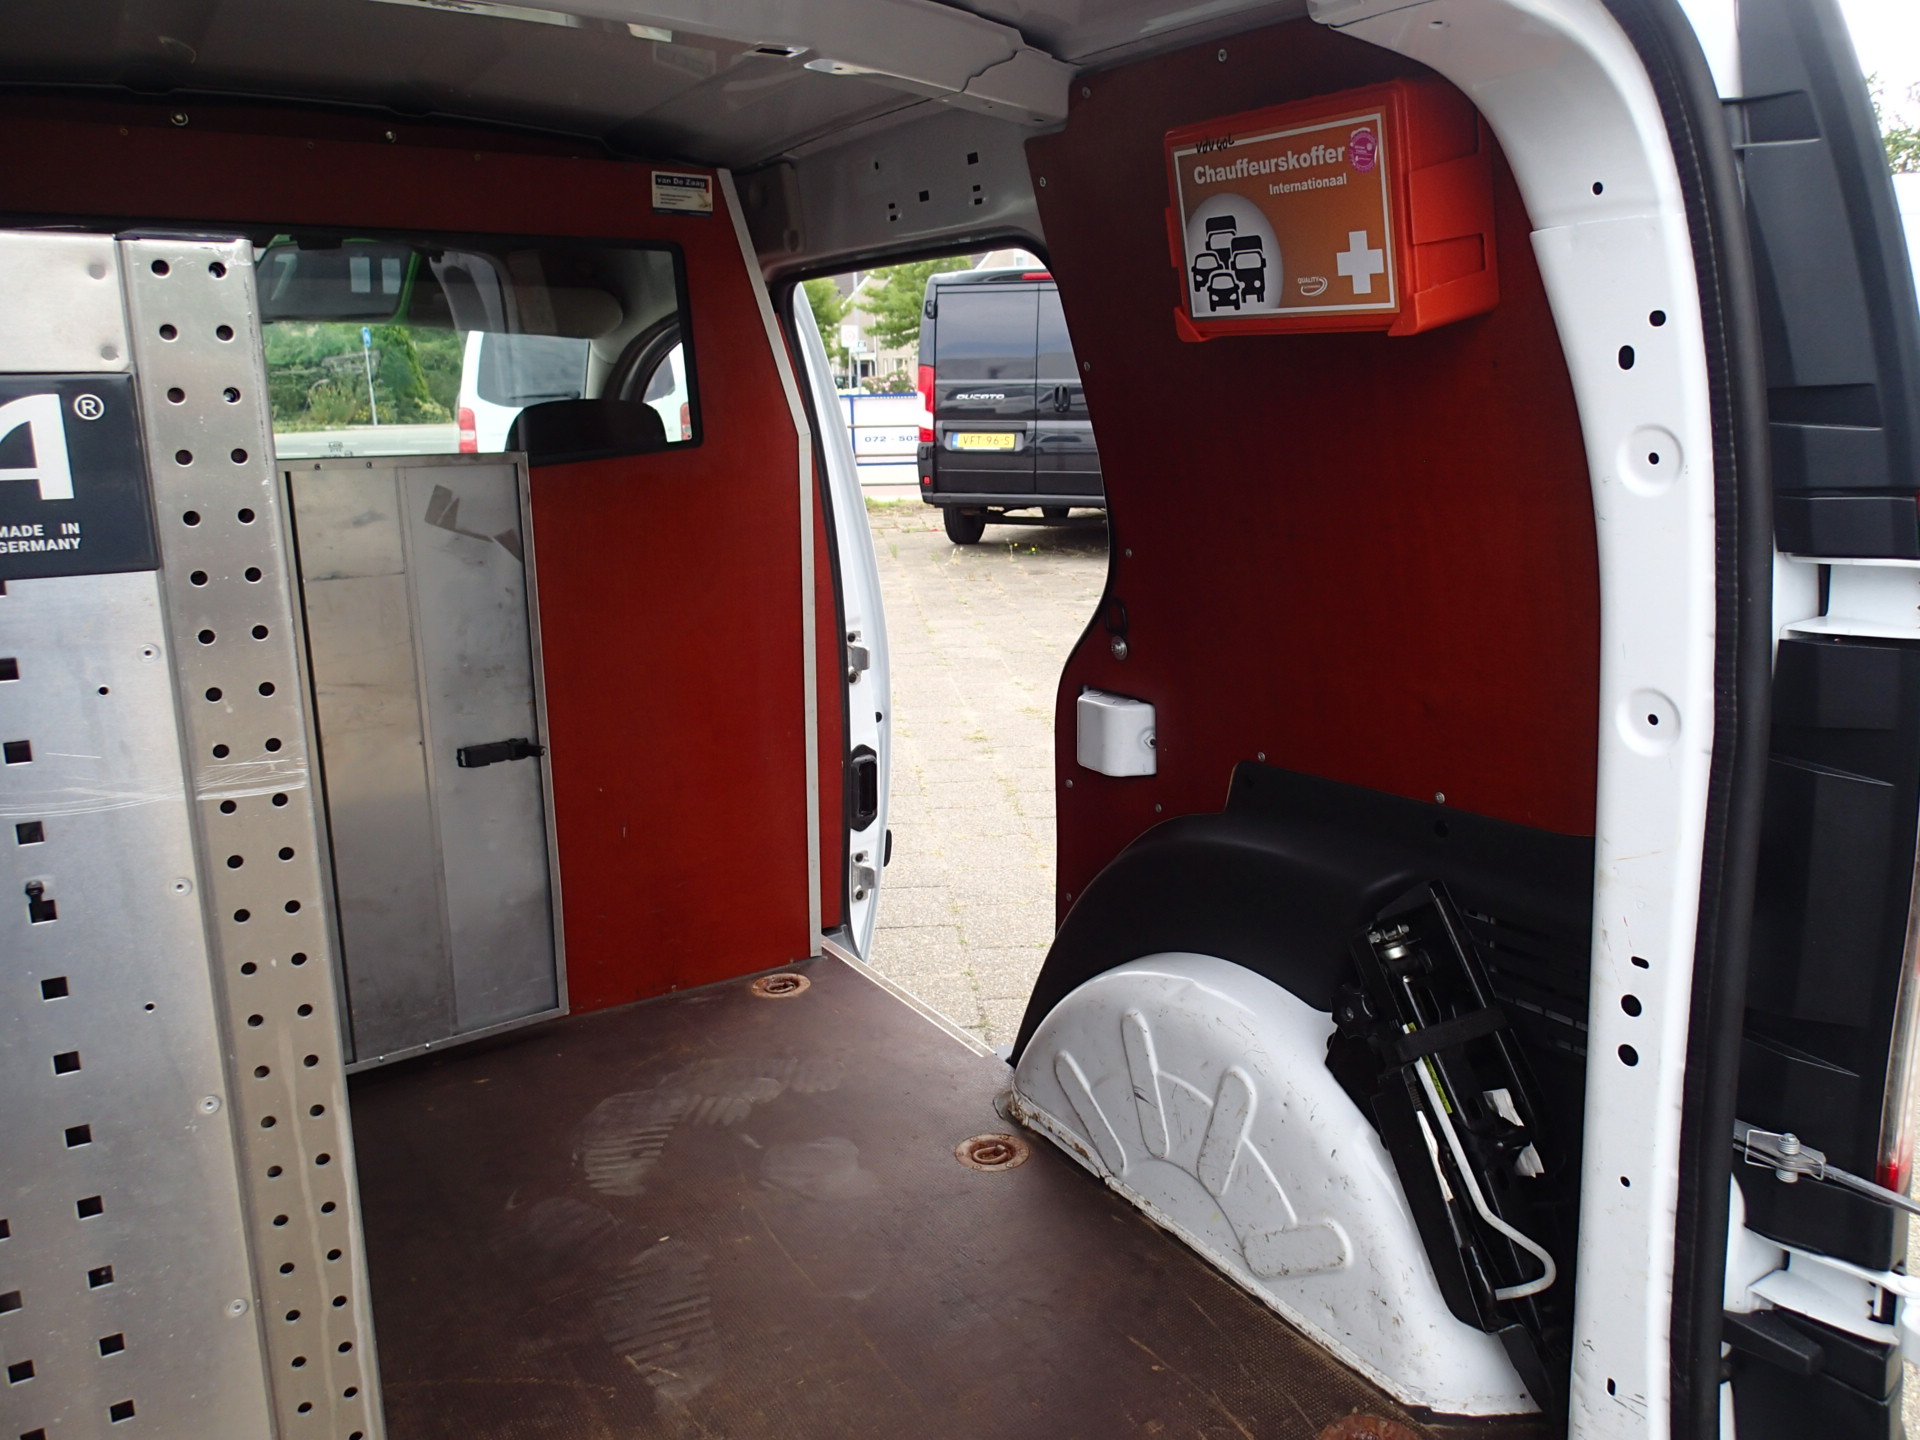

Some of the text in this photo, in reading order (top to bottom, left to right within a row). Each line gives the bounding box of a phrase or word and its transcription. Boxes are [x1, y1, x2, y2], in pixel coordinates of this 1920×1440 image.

[1193, 146, 1345, 184] Chauffeurskoffer
[673, 177, 684, 185] De
[1269, 173, 1347, 195] Internationaal
[1297, 276, 1320, 284] QUALITY
[61, 522, 81, 535] IN
[0, 537, 81, 553] GERMANY
